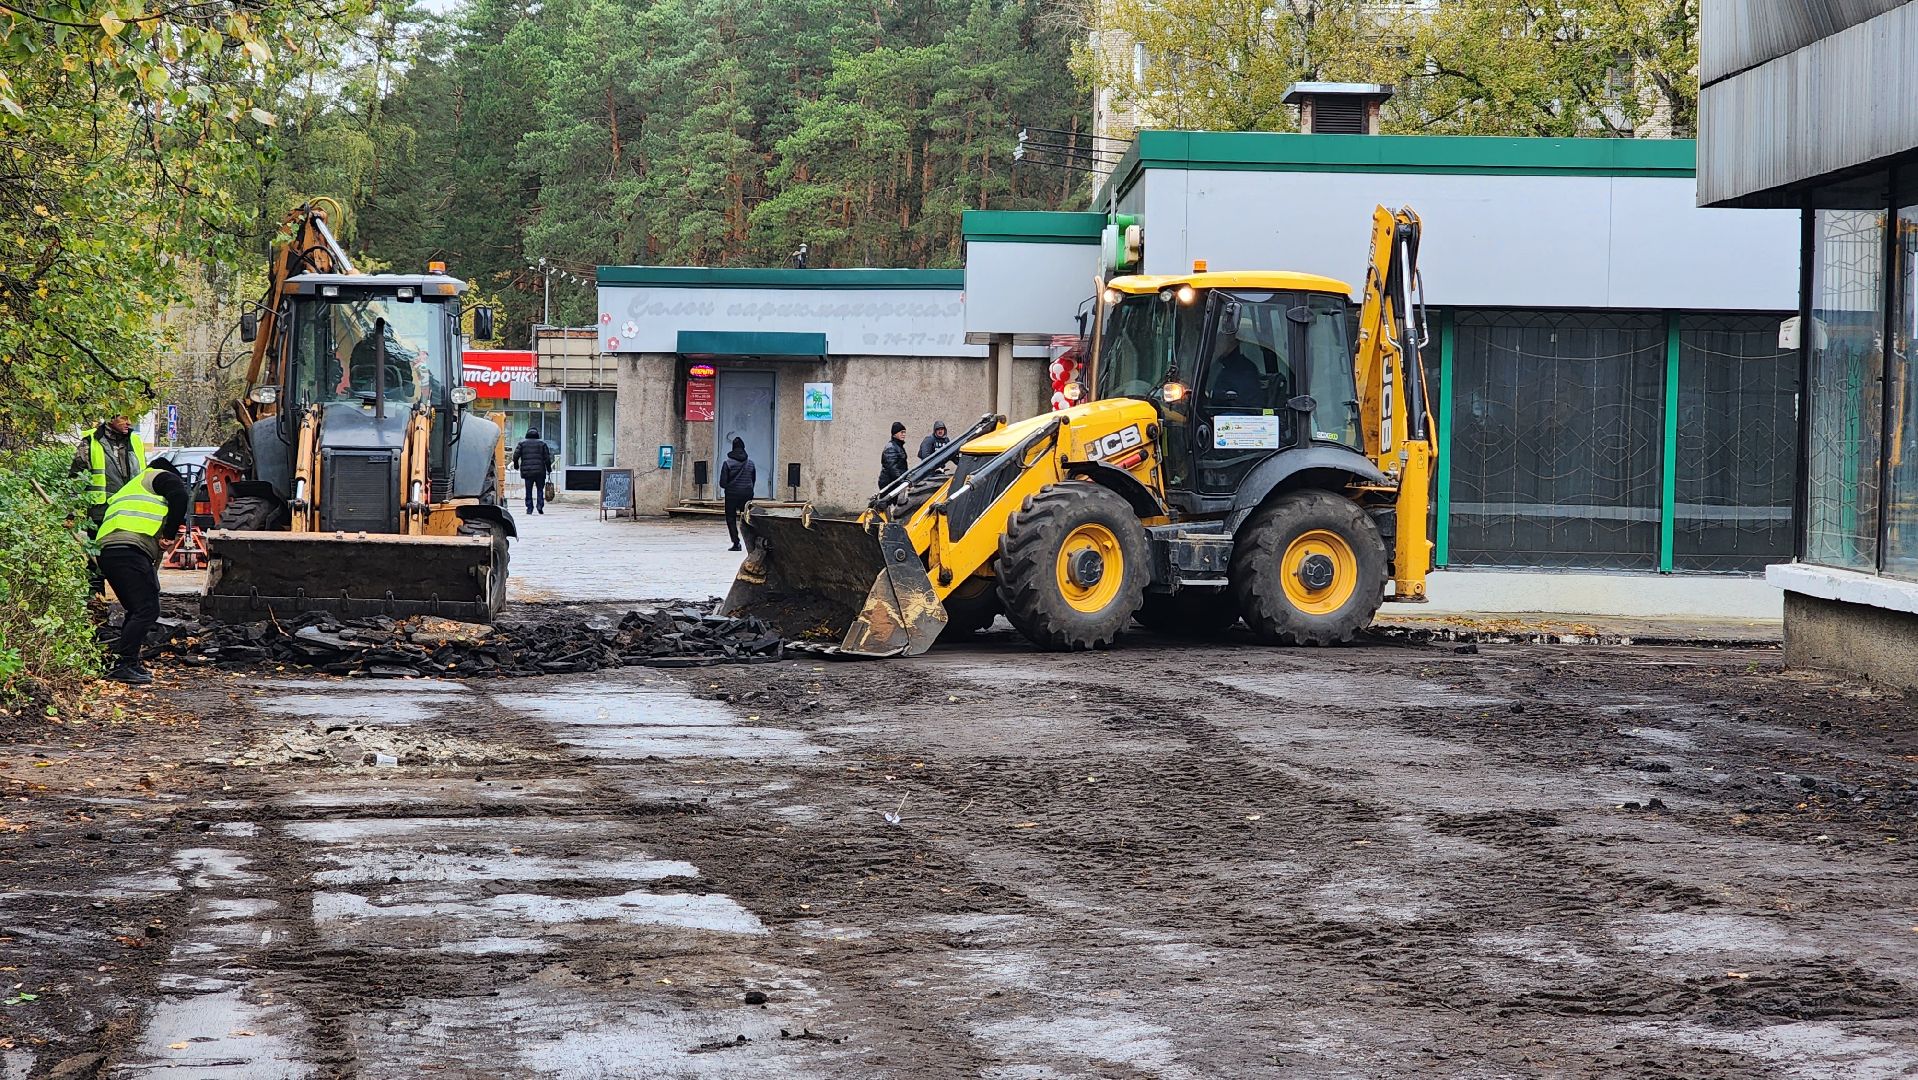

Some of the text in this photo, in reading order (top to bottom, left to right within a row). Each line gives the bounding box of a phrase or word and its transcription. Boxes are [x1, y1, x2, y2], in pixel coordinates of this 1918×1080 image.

[627, 291, 715, 318] Салон
[1382, 356, 1393, 452] JCB
[1085, 425, 1141, 461] JCB
